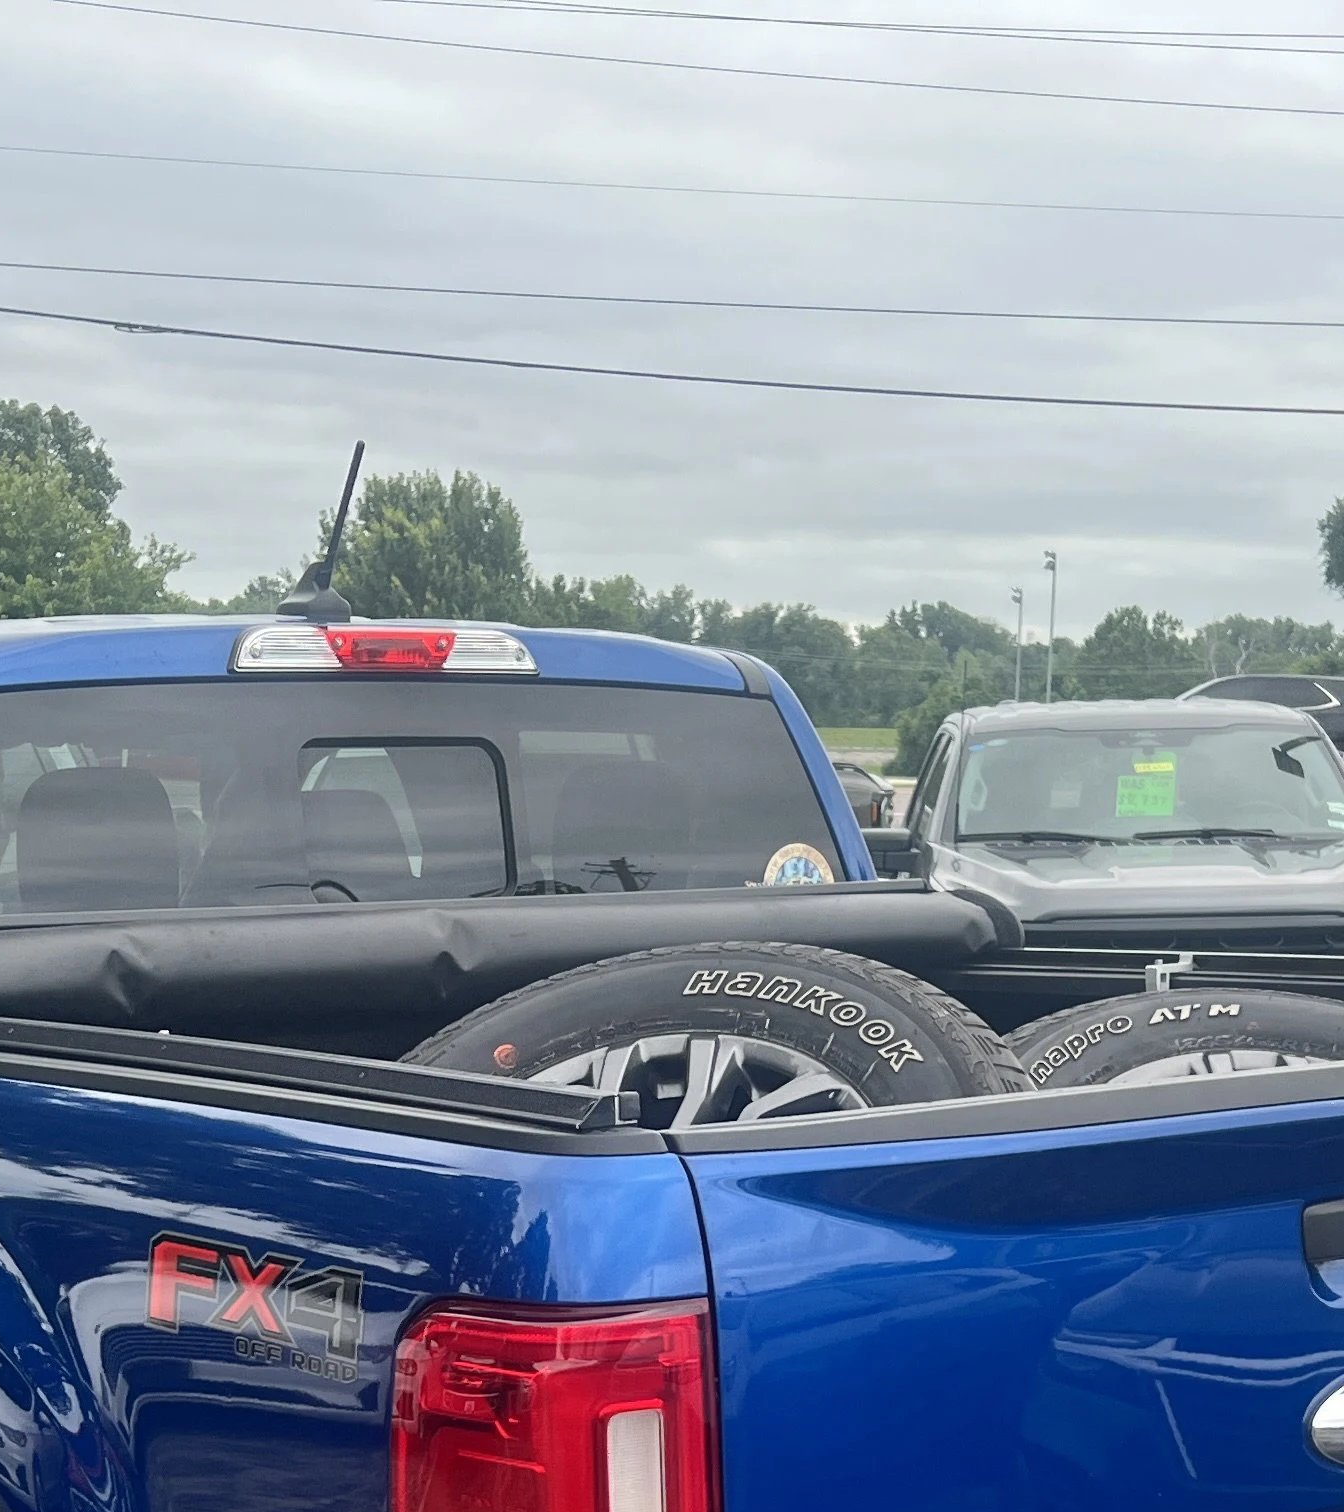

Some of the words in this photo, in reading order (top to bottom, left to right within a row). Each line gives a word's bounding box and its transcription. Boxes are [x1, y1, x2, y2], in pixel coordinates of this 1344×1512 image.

[1028, 1014, 1134, 1084] napro
[144, 1230, 366, 1364] FX4
[234, 1335, 283, 1363] OFF
[289, 1350, 359, 1384] ROAD
